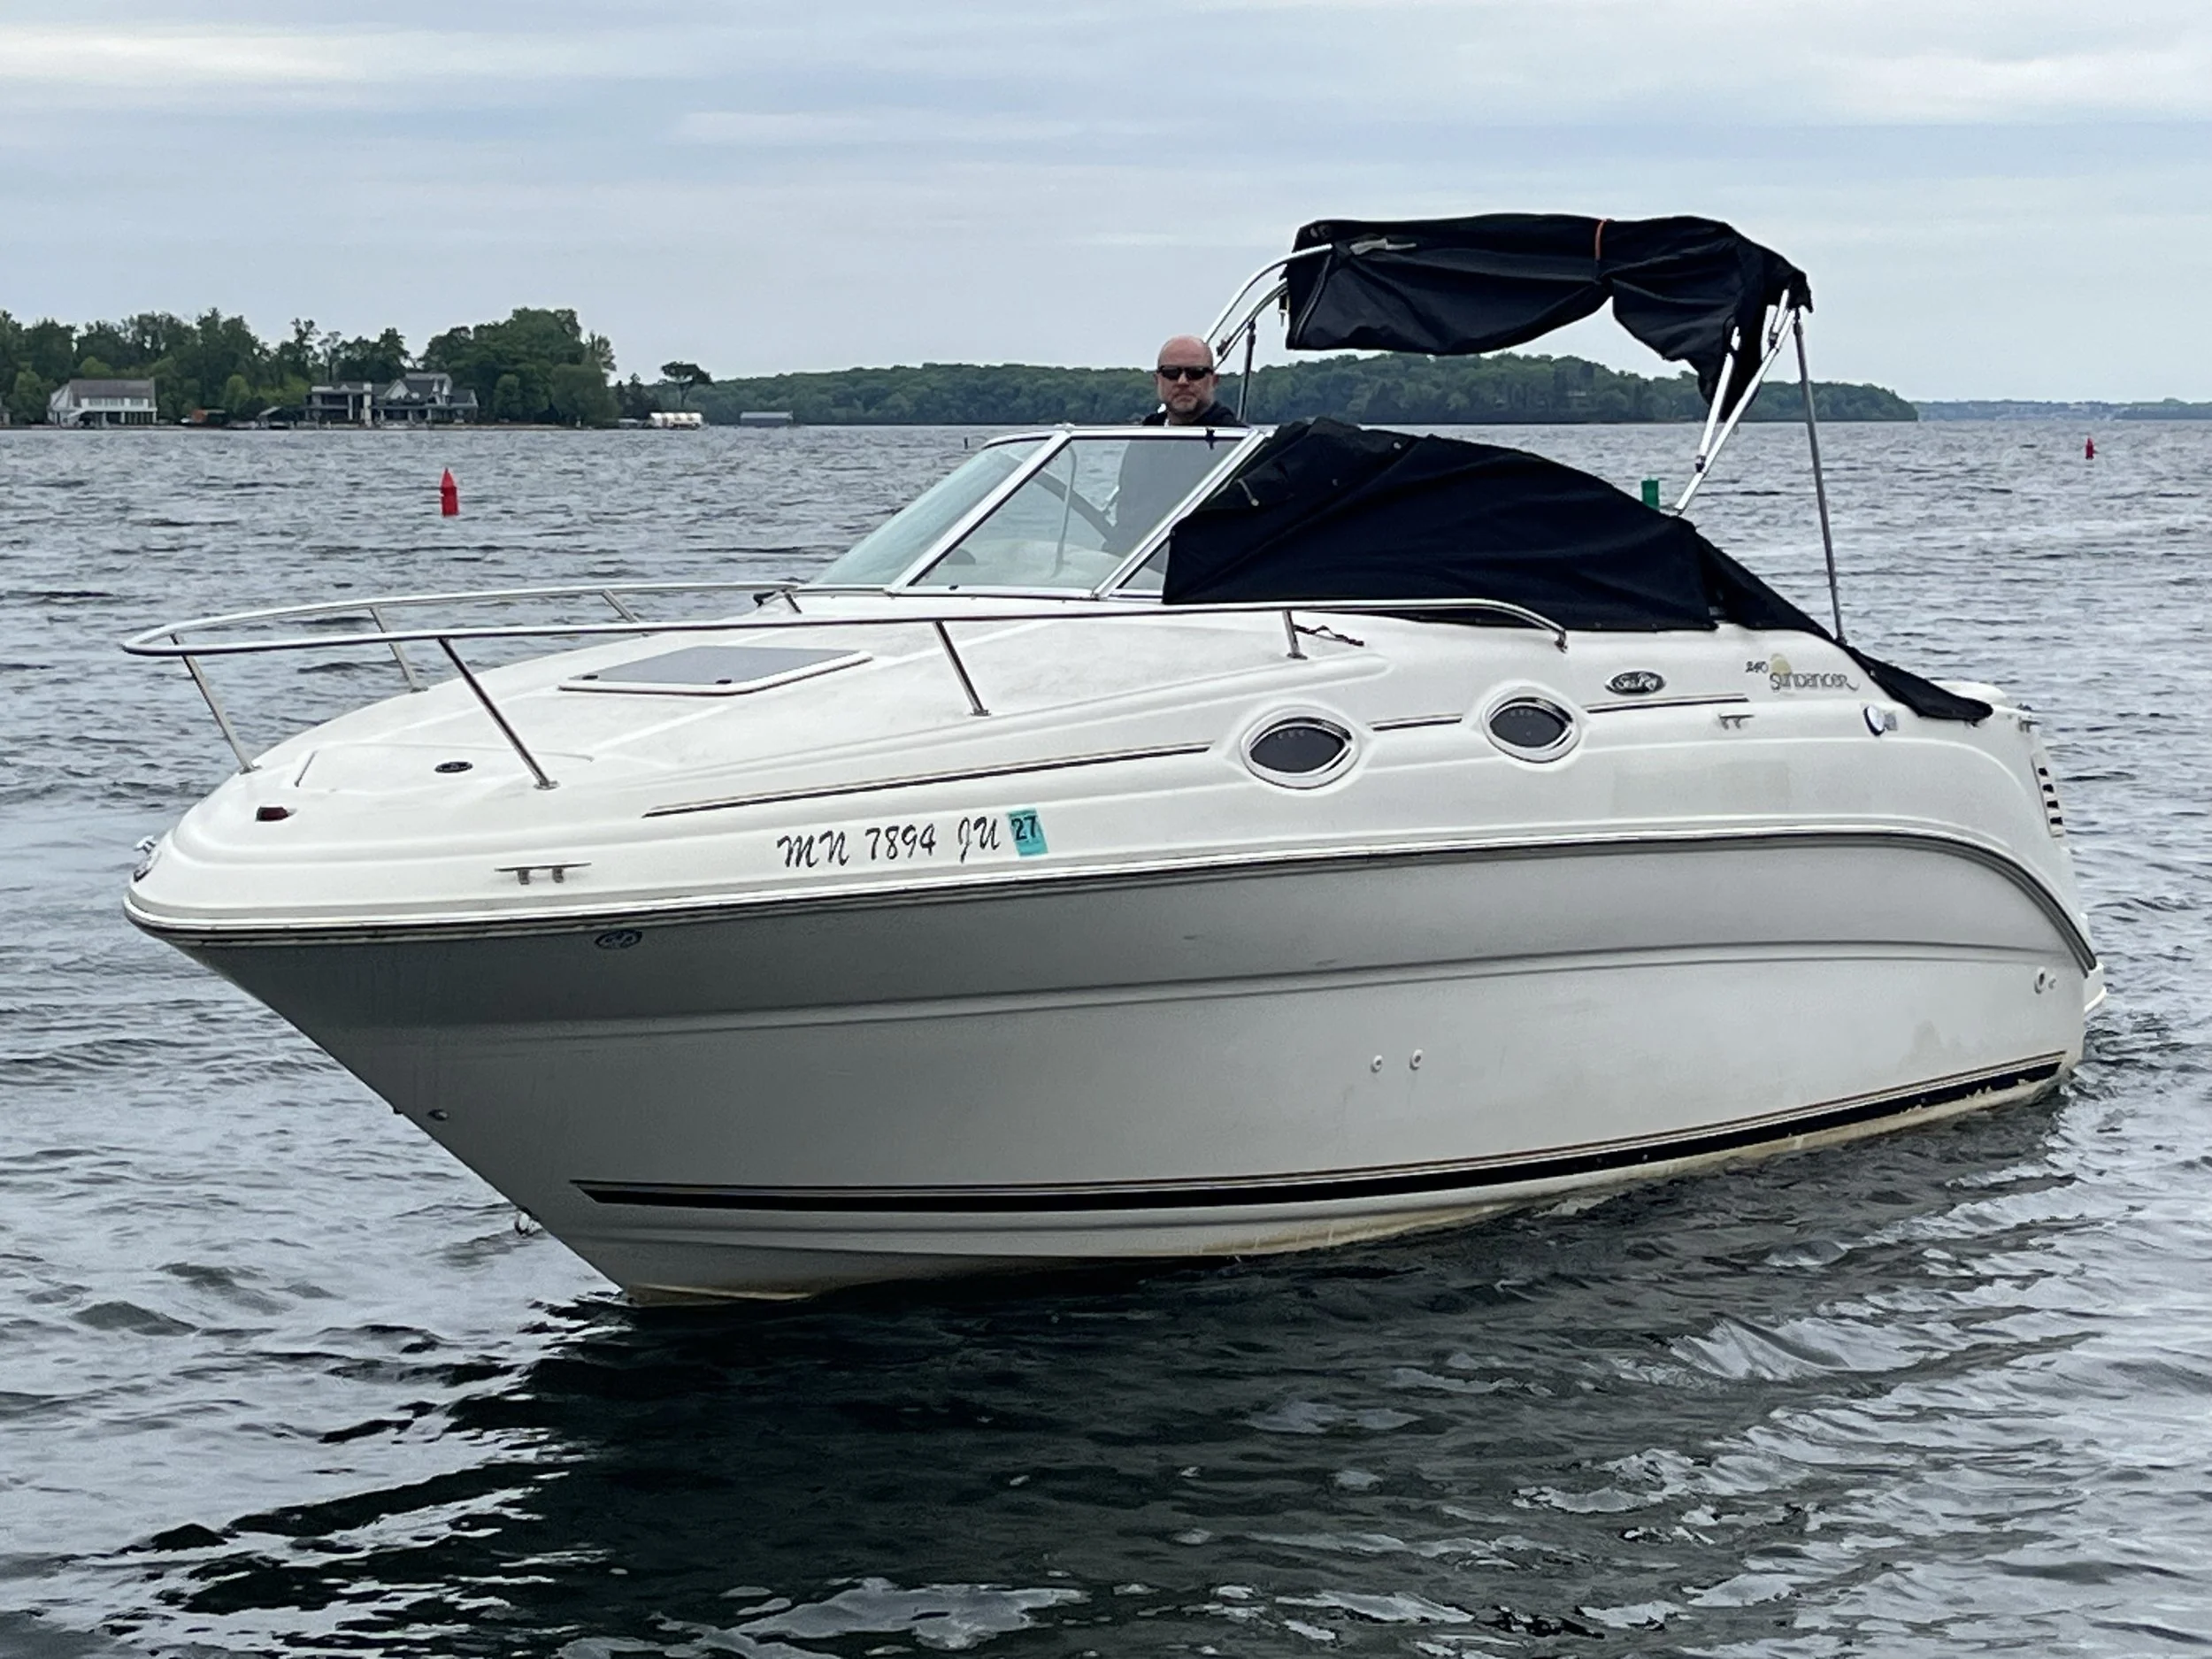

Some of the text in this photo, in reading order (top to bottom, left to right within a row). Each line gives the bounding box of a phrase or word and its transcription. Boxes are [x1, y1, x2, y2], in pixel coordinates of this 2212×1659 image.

[777, 817, 1001, 868] MN 7894 JU
[1010, 815, 1037, 841] 27
